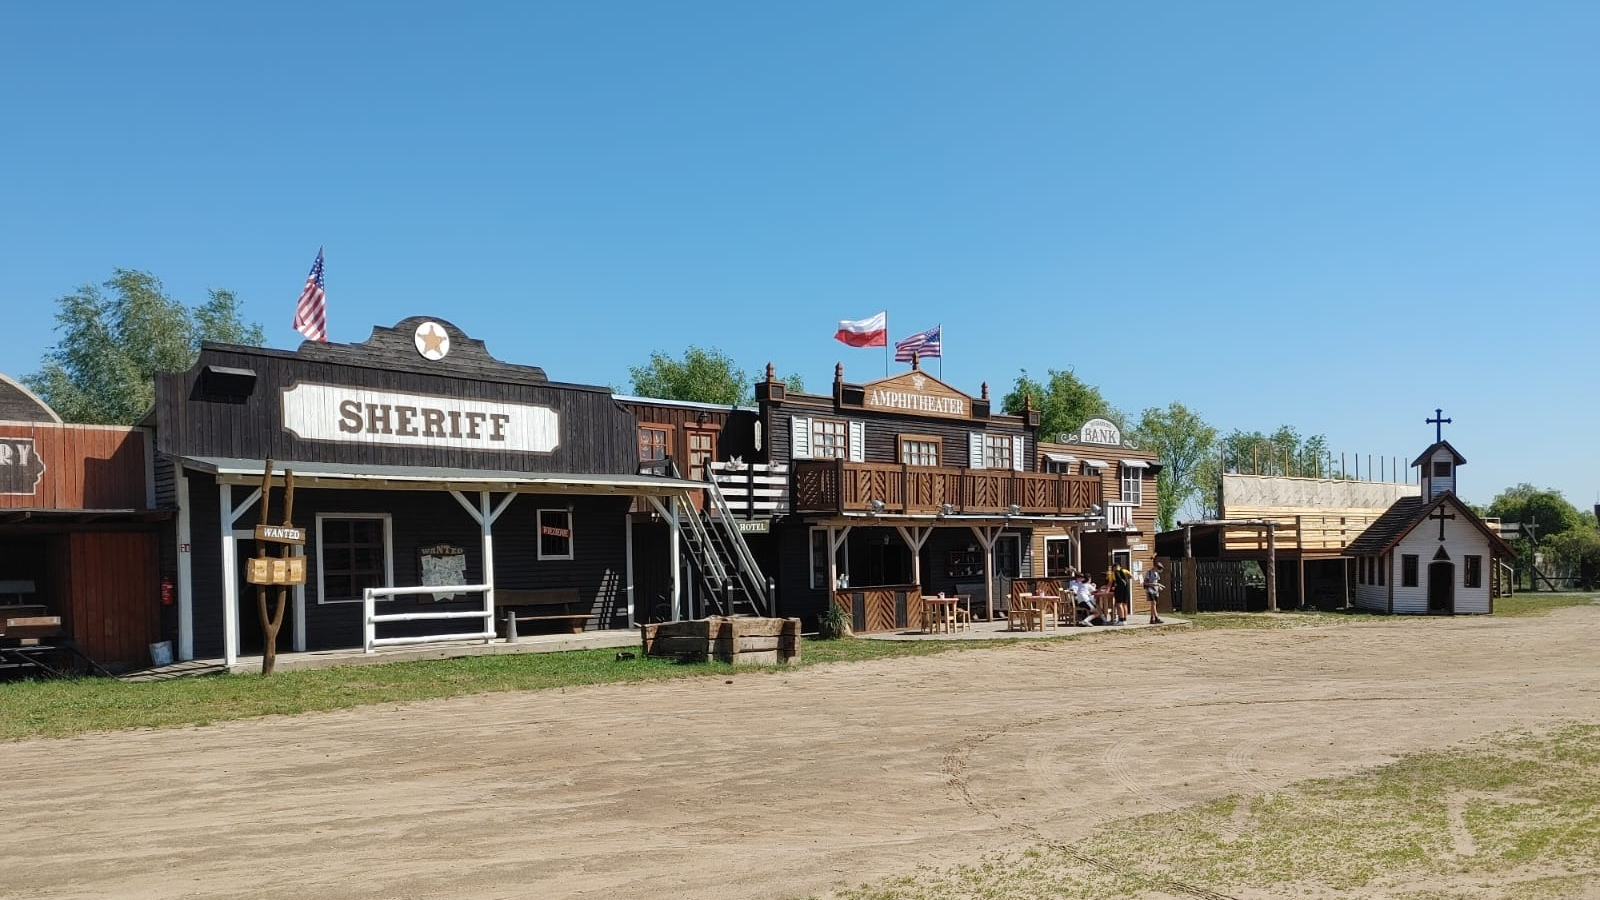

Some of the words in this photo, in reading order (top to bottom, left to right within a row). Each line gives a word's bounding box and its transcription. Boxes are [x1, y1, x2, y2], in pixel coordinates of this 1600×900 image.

[870, 389, 964, 415] AMPHITHEATER
[338, 399, 510, 442] SHERIFF
[1085, 427, 1117, 443] BANK
[264, 527, 300, 540] WANTED
[739, 522, 767, 531] HOTEL
[420, 545, 464, 554] WANTED
